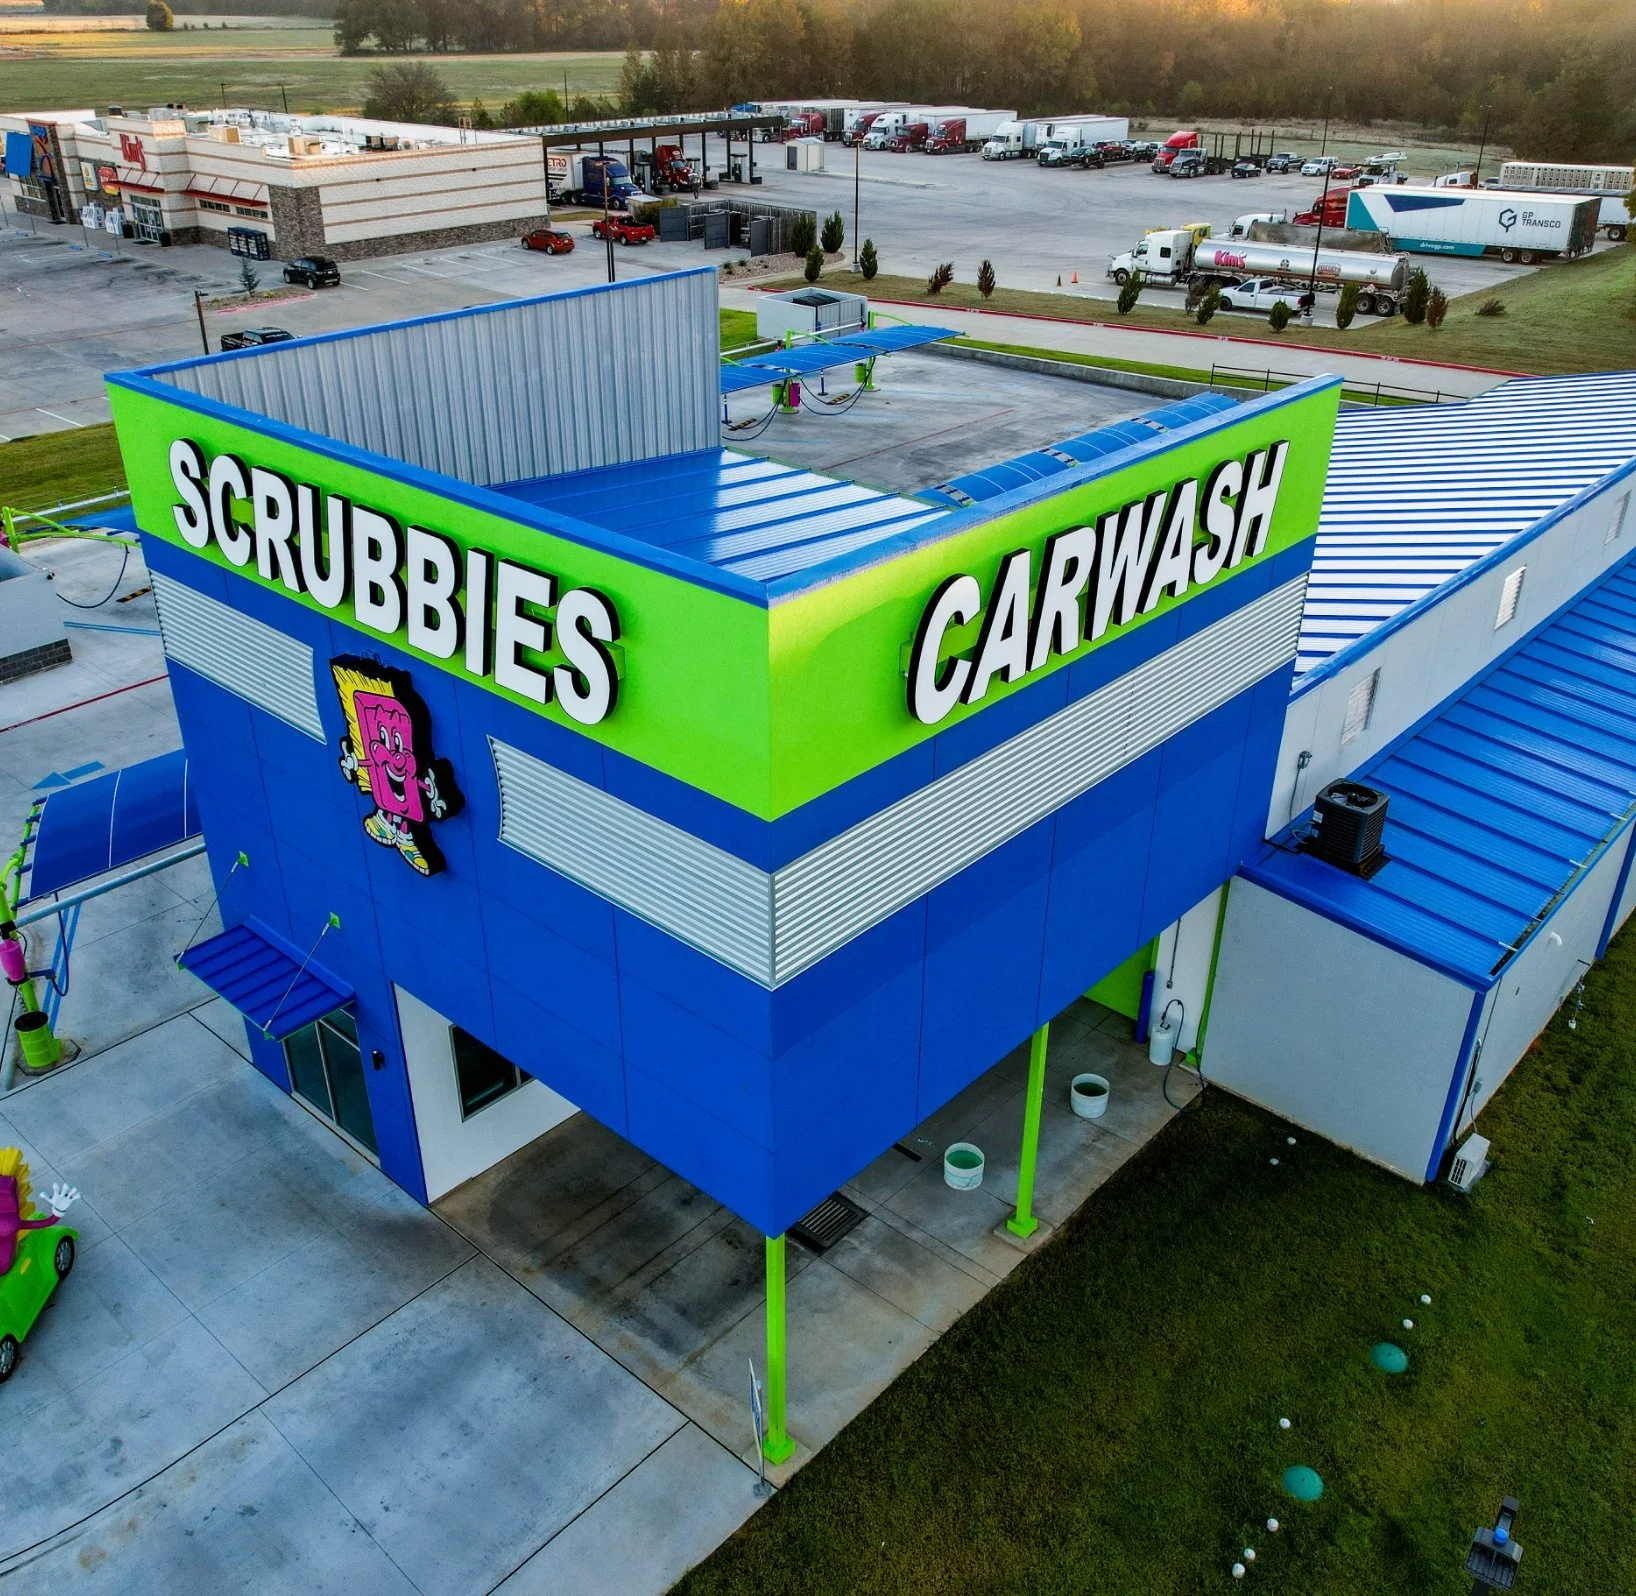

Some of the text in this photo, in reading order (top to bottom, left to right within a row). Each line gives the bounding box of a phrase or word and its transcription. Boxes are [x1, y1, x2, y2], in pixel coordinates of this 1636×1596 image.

[547, 157, 567, 168] ETRO
[1522, 211, 1534, 219] GP
[1522, 218, 1561, 229] TRANSCO
[1420, 242, 1455, 251] drivegp.com
[168, 437, 621, 725] SCRUBBIES
[906, 440, 1291, 725] CARWASH
